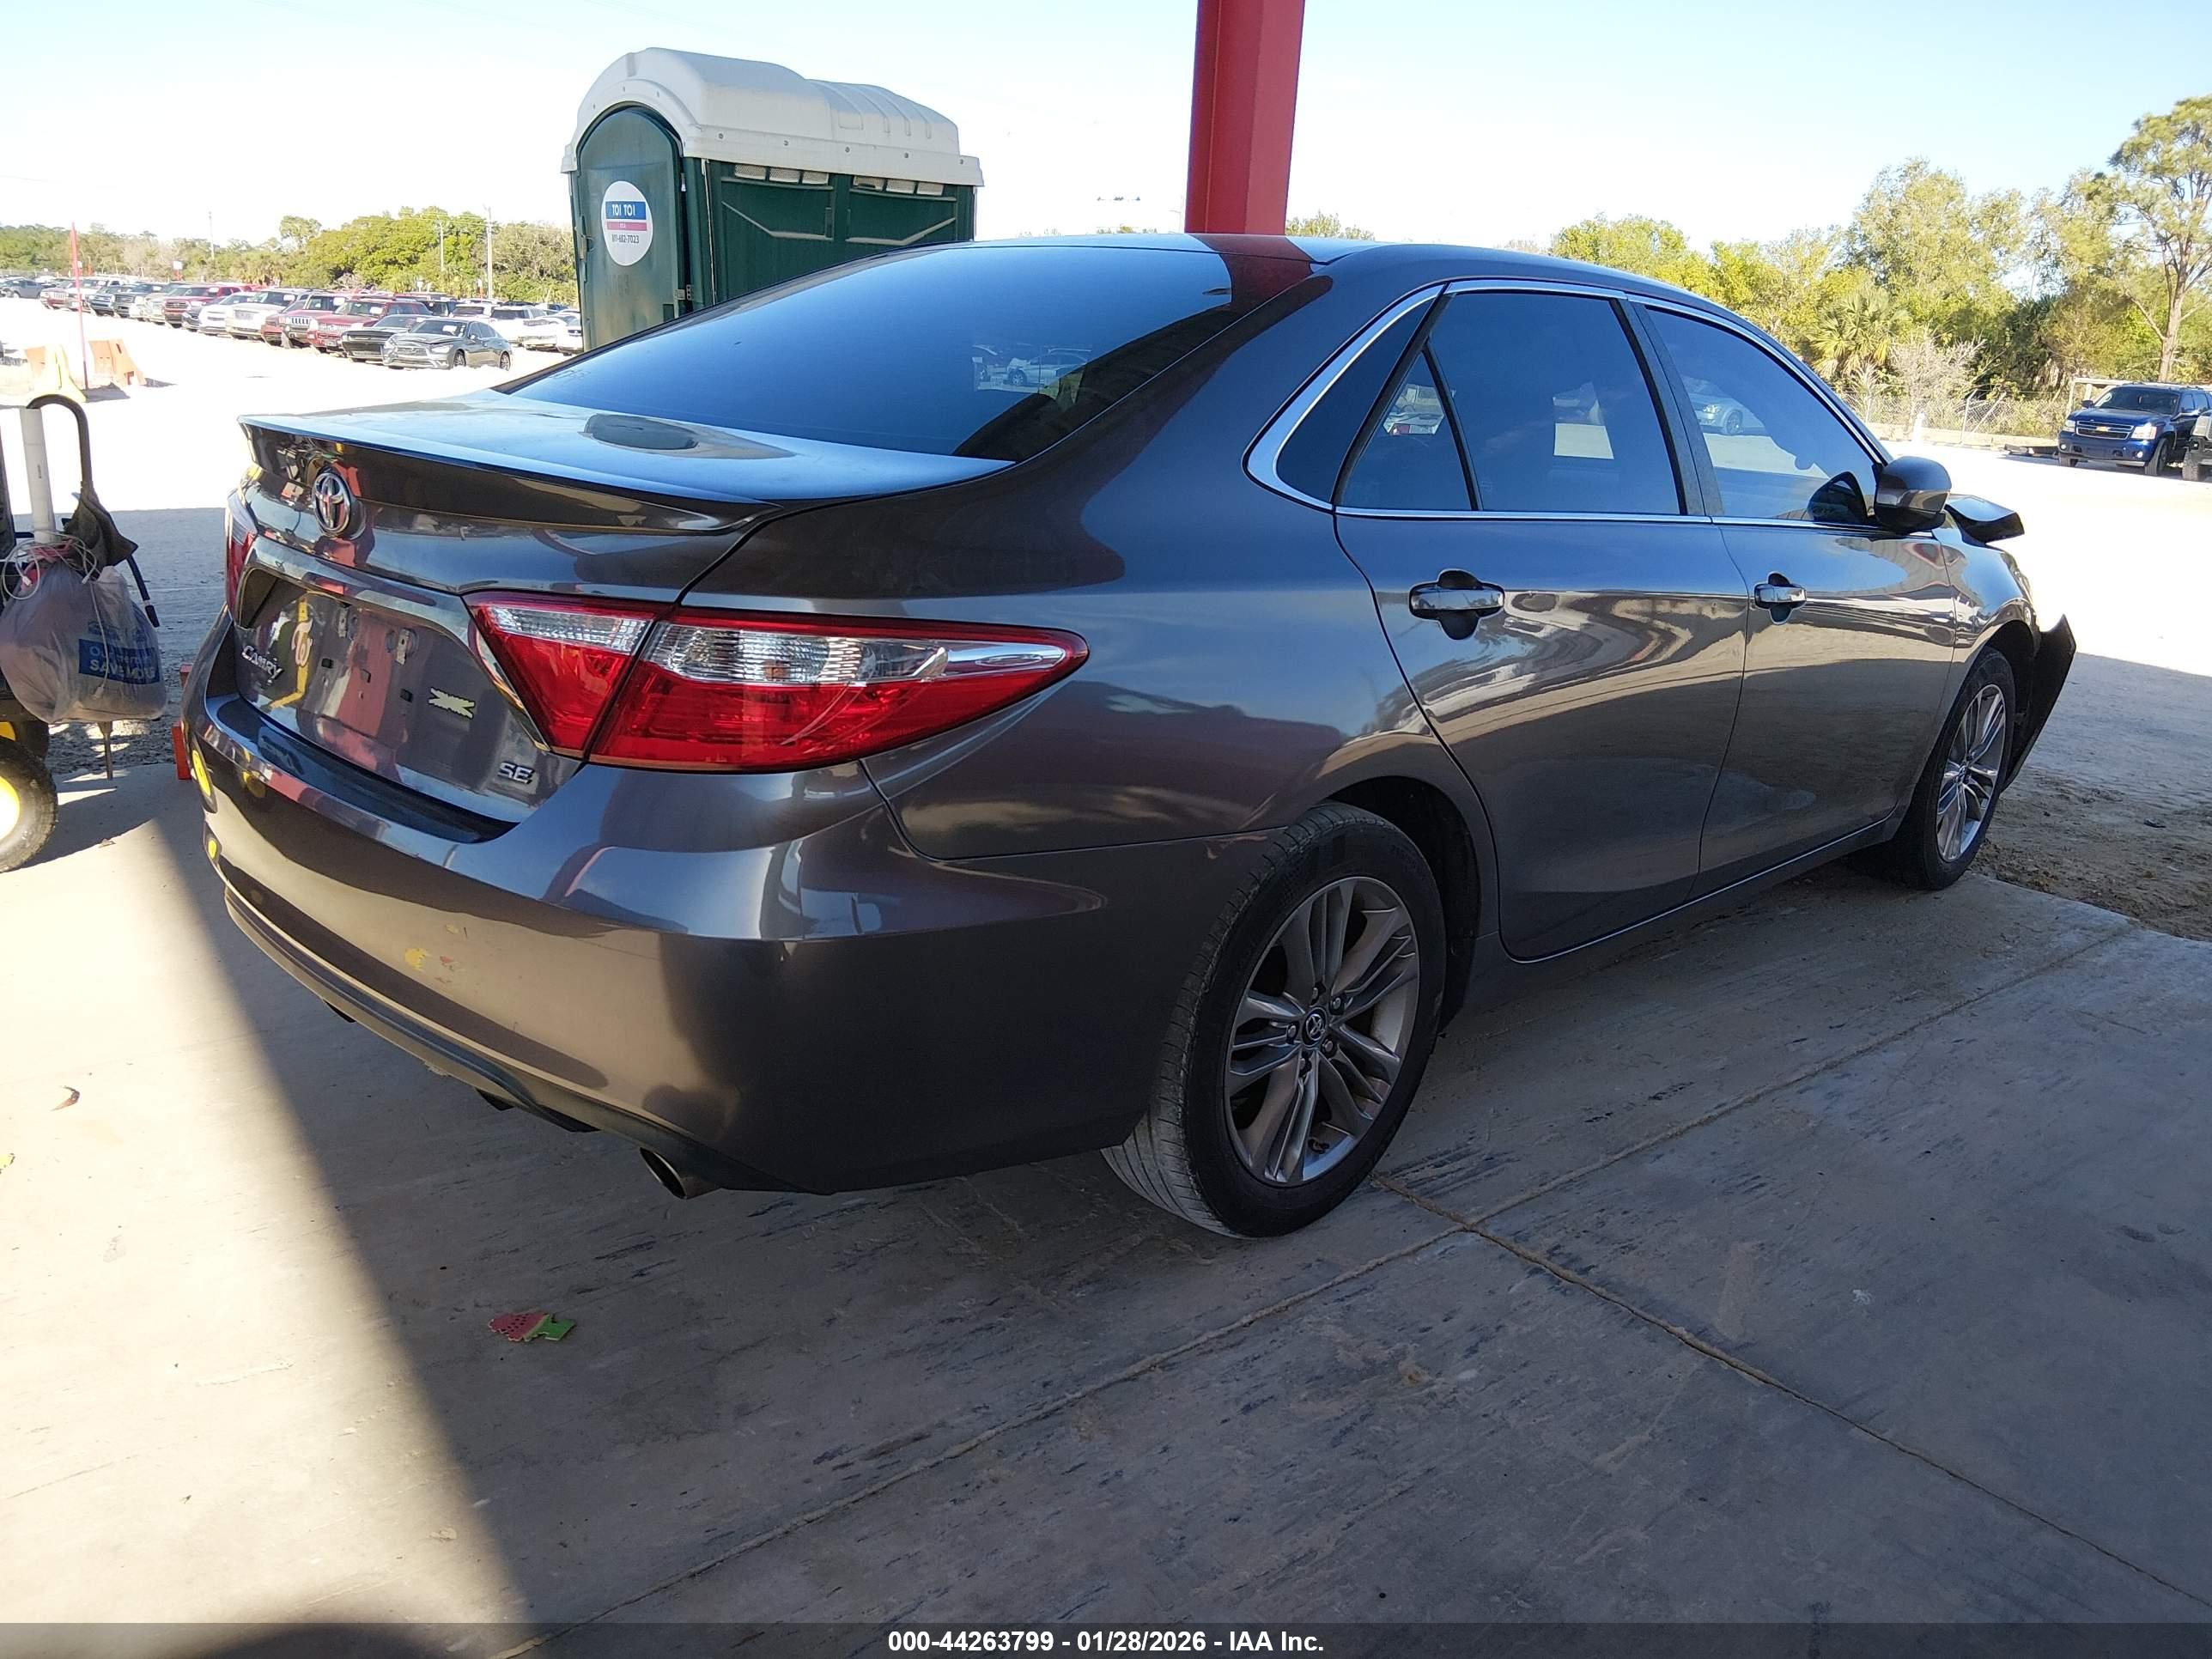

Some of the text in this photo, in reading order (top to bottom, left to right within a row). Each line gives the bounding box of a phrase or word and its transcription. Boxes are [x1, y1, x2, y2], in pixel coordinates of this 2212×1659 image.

[611, 204, 635, 216] TOI TOI
[498, 762, 534, 784] SE
